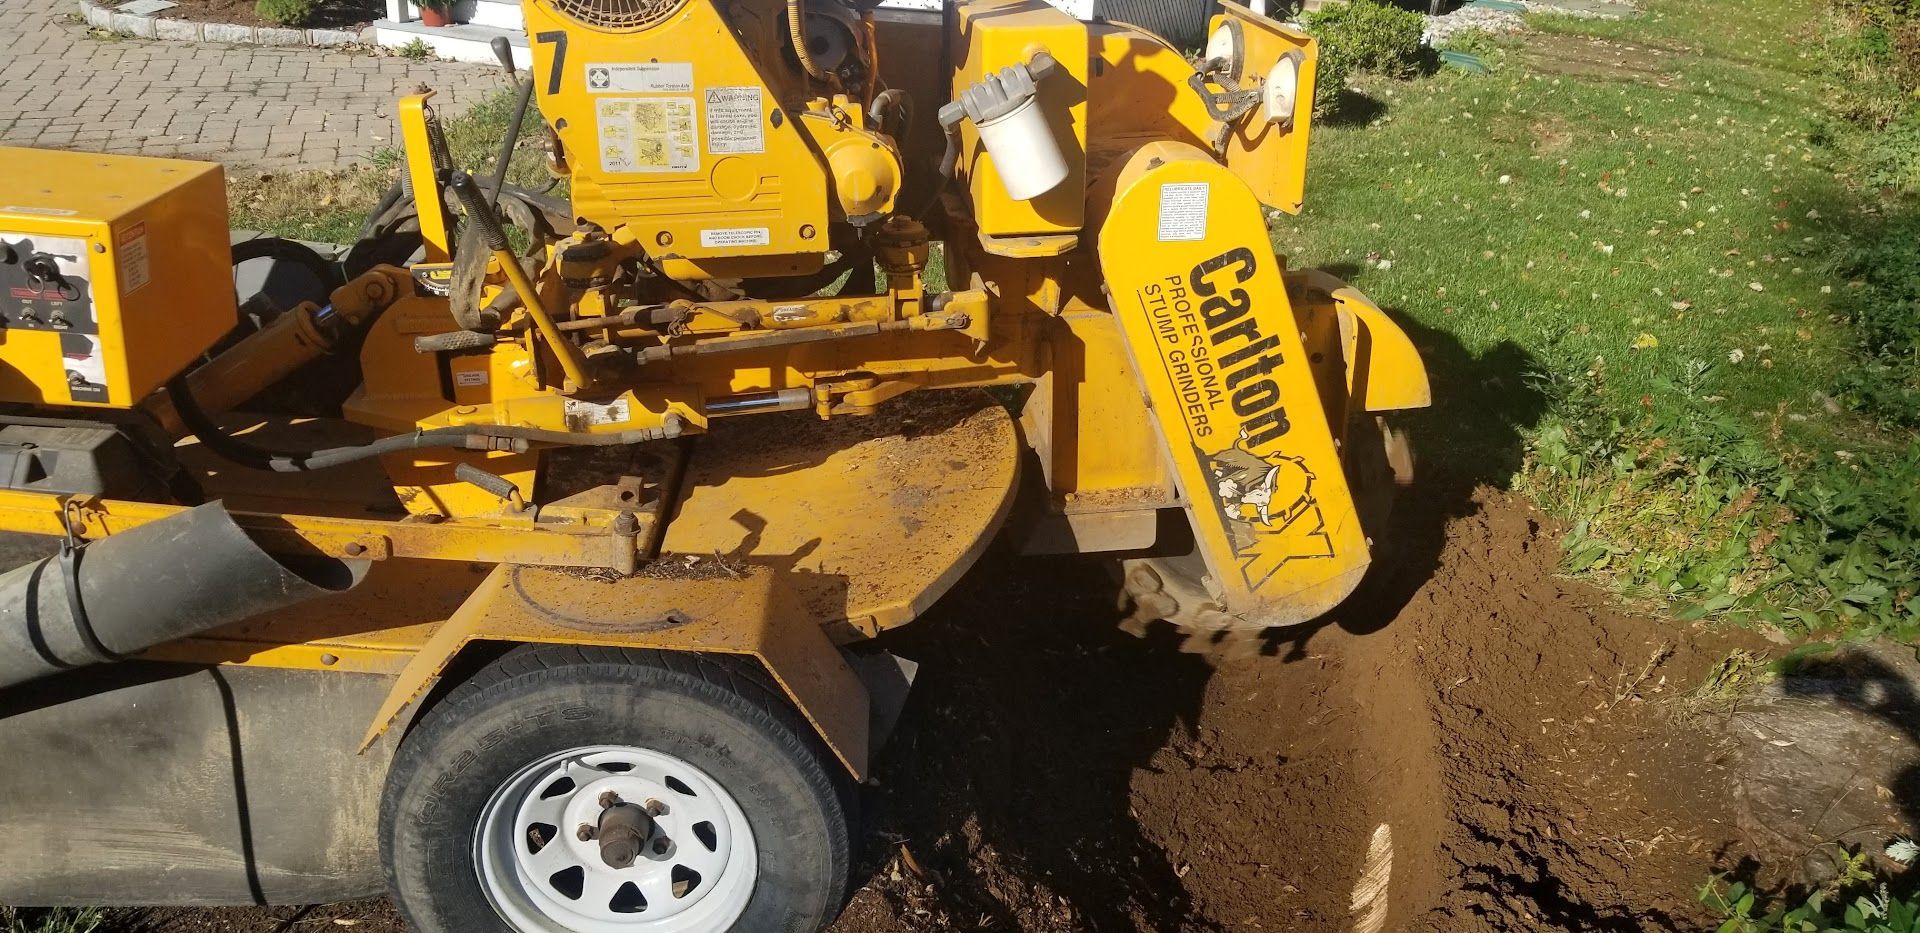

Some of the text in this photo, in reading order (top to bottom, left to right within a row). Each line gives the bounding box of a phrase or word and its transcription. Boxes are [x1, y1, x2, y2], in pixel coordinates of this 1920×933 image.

[536, 30, 568, 95] 7
[720, 94, 759, 102] WARNING
[1144, 283, 1213, 438] STUMP GRINDERS
[1164, 275, 1225, 411] PROFESSIONAL
[1190, 247, 1291, 449] Carlton
